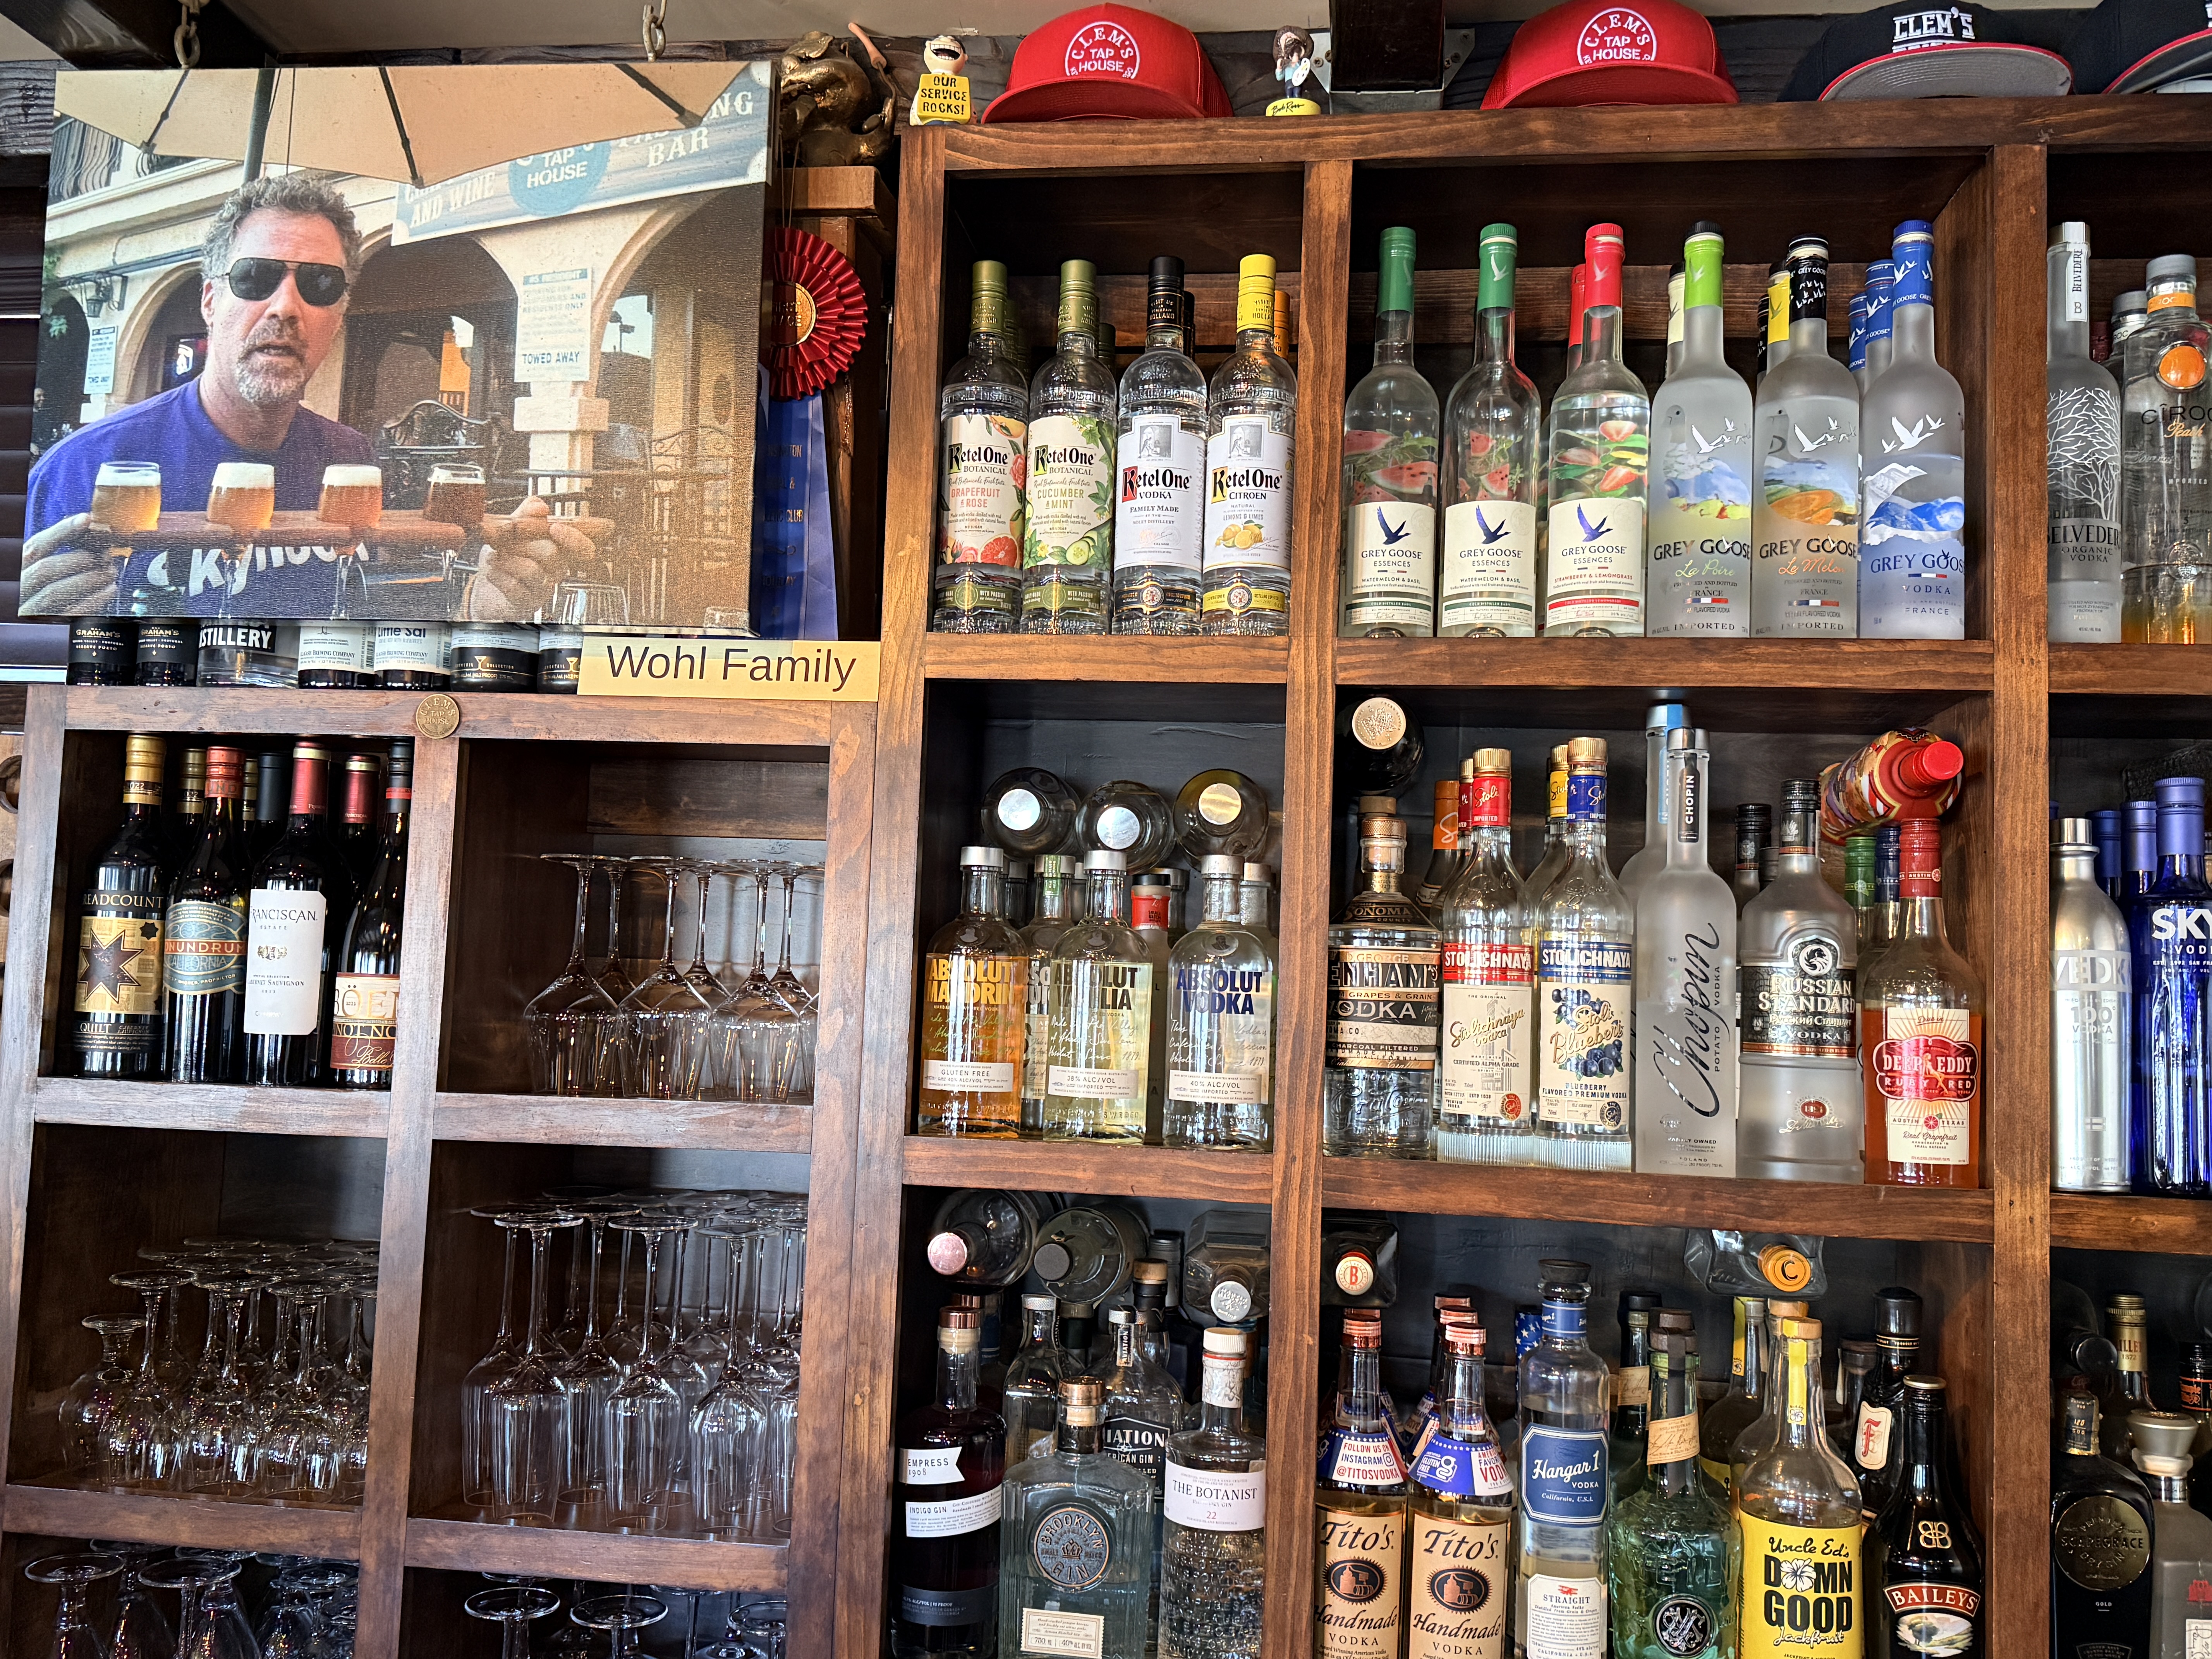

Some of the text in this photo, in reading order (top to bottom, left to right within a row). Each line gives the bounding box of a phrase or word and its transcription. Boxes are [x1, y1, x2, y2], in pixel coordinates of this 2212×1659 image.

[1894, 7, 1974, 39] CLEM'S
[1585, 14, 1650, 47] CLEM'S
[1072, 27, 1133, 59] CLEM'S
[1604, 36, 1630, 47] TAP
[1089, 48, 1114, 59] TAP
[1593, 48, 1641, 60] HOUSE
[1079, 60, 1124, 72] HOUSE
[934, 76, 956, 87] OUR
[921, 88, 967, 101] SERVICE
[923, 102, 964, 115] ROCKS!
[1271, 104, 1285, 116] Bob
[647, 127, 709, 167] BAR
[542, 148, 575, 167] TAP
[527, 163, 587, 188] HOUSE
[411, 195, 443, 227] AND
[449, 173, 496, 211] WINE
[2073, 249, 2082, 292] BELVEDERE
[1150, 312, 1175, 320] HOLLAND
[522, 351, 579, 364] TOWED AWAY
[2164, 419, 2205, 438] Peach
[948, 445, 1008, 474] Ketel One
[1034, 445, 1094, 475] Ketel One
[964, 466, 1007, 475] BOTANICAL
[1049, 467, 1093, 476] BOTANICAL
[1123, 468, 1190, 499] Ketel One
[1212, 468, 1280, 499] Ketel One
[951, 488, 1000, 498] GRAPEFRUIT
[1037, 488, 1084, 499] CUCUMBER
[1140, 491, 1171, 499] VODKA
[966, 499, 988, 508] ROSE
[1051, 500, 1074, 509] MINT
[787, 509, 804, 523] CLUB
[1362, 549, 1422, 559] GREY GOOSE
[1460, 549, 1523, 558] GREY GOOSE
[1562, 545, 1626, 556] GREY GOOSE
[1654, 539, 1750, 560] GREY GOOSE
[1760, 538, 1857, 559] GREY GOOSE
[2062, 546, 2112, 555] ORGANIC
[1702, 559, 1735, 576] Poire
[1802, 559, 1846, 573] Melon
[1871, 554, 1917, 573] GREY
[1903, 586, 1951, 595] VODKA
[76, 629, 120, 638] GRAHAM'S
[607, 645, 856, 692] Wohl Family
[1475, 785, 1499, 807] Stoli
[1685, 775, 1694, 824] CHOPIN
[1445, 952, 1532, 969] STOLICHNAYA
[1542, 949, 1630, 968] STOLICHNAYA
[1176, 969, 1262, 993] ABSOLUT
[1771, 975, 1851, 996] RUSSIAN
[1183, 991, 1254, 1015] VODKA
[1758, 991, 1855, 1013] STANDARD
[1572, 1000, 1612, 1034] Stoli
[1653, 922, 1729, 1117] Chopin
[80, 1022, 112, 1033] QUILT
[1450, 1009, 1525, 1048] Stolichnaya
[2073, 1025, 2113, 1034] VODKA
[1474, 1029, 1507, 1047] vodka
[1786, 1031, 1841, 1040] VODKA
[1883, 1055, 1973, 1073] DEEP EDDY
[1565, 1083, 1606, 1091] BLUEBERRY
[1885, 1077, 1971, 1089] RUBY RED
[1922, 1132, 1958, 1144] Grapefruit
[1781, 1260, 1798, 1281] C
[1344, 1443, 1368, 1452] FOLLOW
[908, 1458, 949, 1467] EMPRESS
[1139, 1454, 1153, 1464] GIN
[1341, 1453, 1382, 1465] INSTAGRAM
[1422, 1457, 1440, 1468] GLUTEN
[1532, 1450, 1599, 1482] Hangar 1
[909, 1468, 926, 1477] 1908
[1337, 1466, 1399, 1480] @TITOSVODKA
[1419, 1465, 1431, 1473] FREE
[1173, 1480, 1257, 1500] THE BOTANIST
[1207, 1511, 1216, 1519] 22
[1040, 1514, 1104, 1549] BROOKLYN
[1769, 1537, 1849, 1558] Uncle Ed's
[2061, 1537, 2143, 1549] SCAPEGRACE
[1052, 1561, 1090, 1581] GIN
[1543, 1594, 1590, 1604] STRAIGHT
[1893, 1588, 1977, 1611] BAILEYS
[1314, 1604, 1396, 1629] Handmade
[1764, 1590, 1852, 1634] GOOD
[1413, 1613, 1501, 1639] Handmade
[1329, 1633, 1379, 1645] VODKA
[1774, 1626, 1844, 1647] Jackfruit
[1433, 1642, 1482, 1655] VODKA
